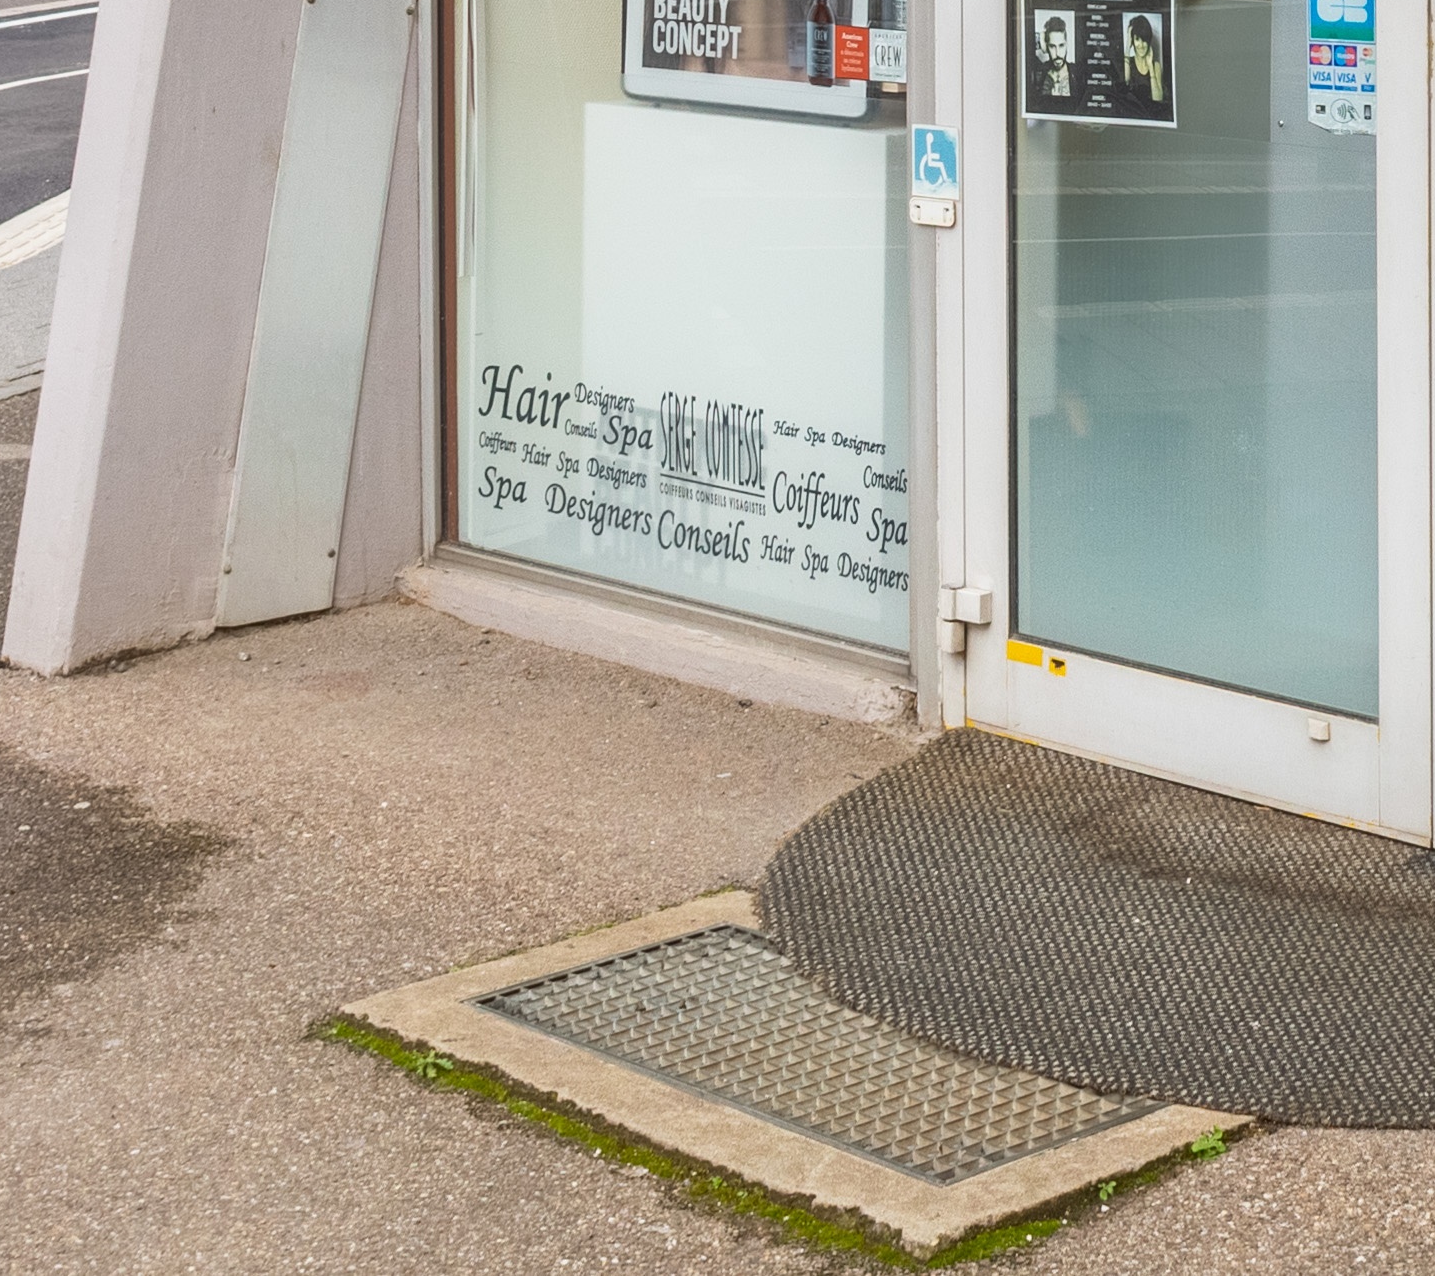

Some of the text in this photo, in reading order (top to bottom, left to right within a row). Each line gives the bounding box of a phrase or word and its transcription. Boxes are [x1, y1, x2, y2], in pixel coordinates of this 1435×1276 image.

[652, 20, 742, 60] CONCEPT
[874, 44, 902, 67] CREW
[1313, 71, 1332, 82] VISA
[1337, 72, 1356, 84] VISA
[478, 364, 570, 430] Hair
[574, 382, 635, 415] Designers
[564, 414, 654, 455] Conseils Spa
[659, 390, 766, 491] SERGE COMTESSE
[773, 419, 887, 456] Hair Spa Designers
[478, 431, 648, 491] Coiffeurs Hair Spa Designers
[863, 464, 908, 495] Conseils
[659, 482, 766, 517] COIFFEURS CONSEILS VISAGISTES
[772, 470, 860, 530] Coiffeurs
[478, 466, 910, 595] Spa Designers Conseils Hair Spa Designers
[866, 507, 908, 553] Spa
